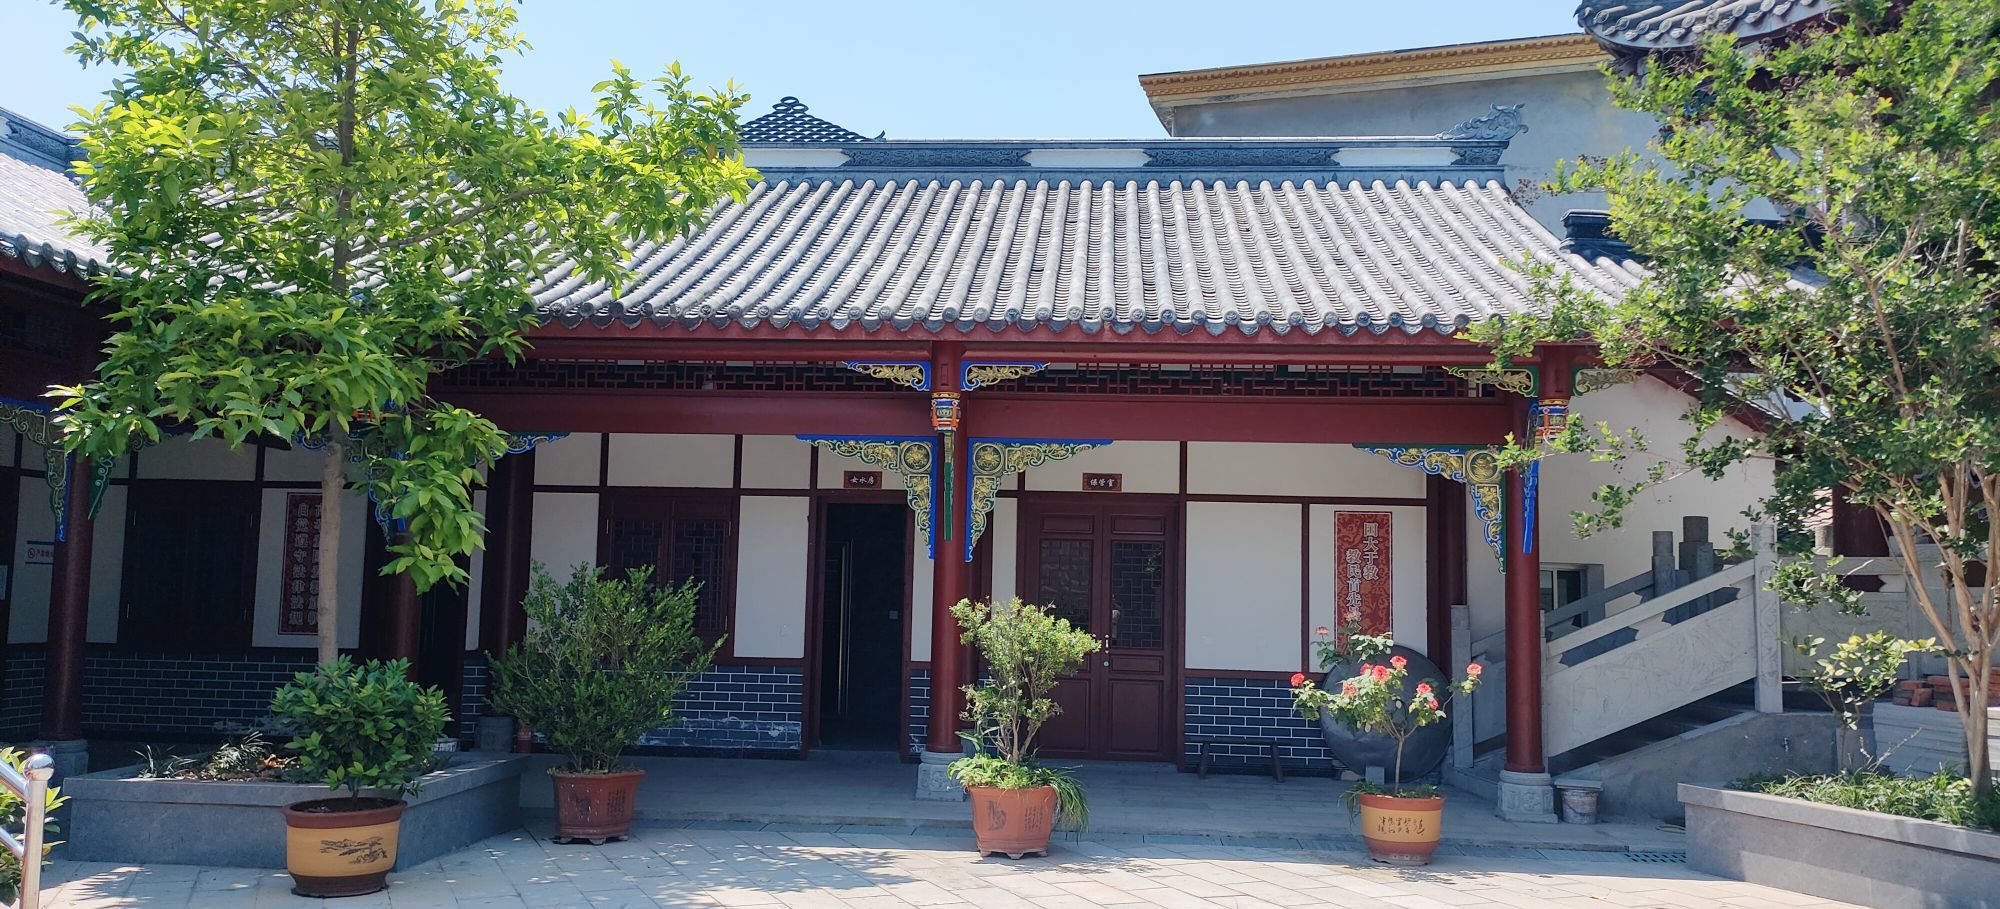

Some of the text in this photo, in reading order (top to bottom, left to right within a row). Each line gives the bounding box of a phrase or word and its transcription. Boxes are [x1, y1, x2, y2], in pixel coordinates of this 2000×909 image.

[1090, 478, 1115, 487] 保管室
[1363, 522, 1379, 580] 国大于教
